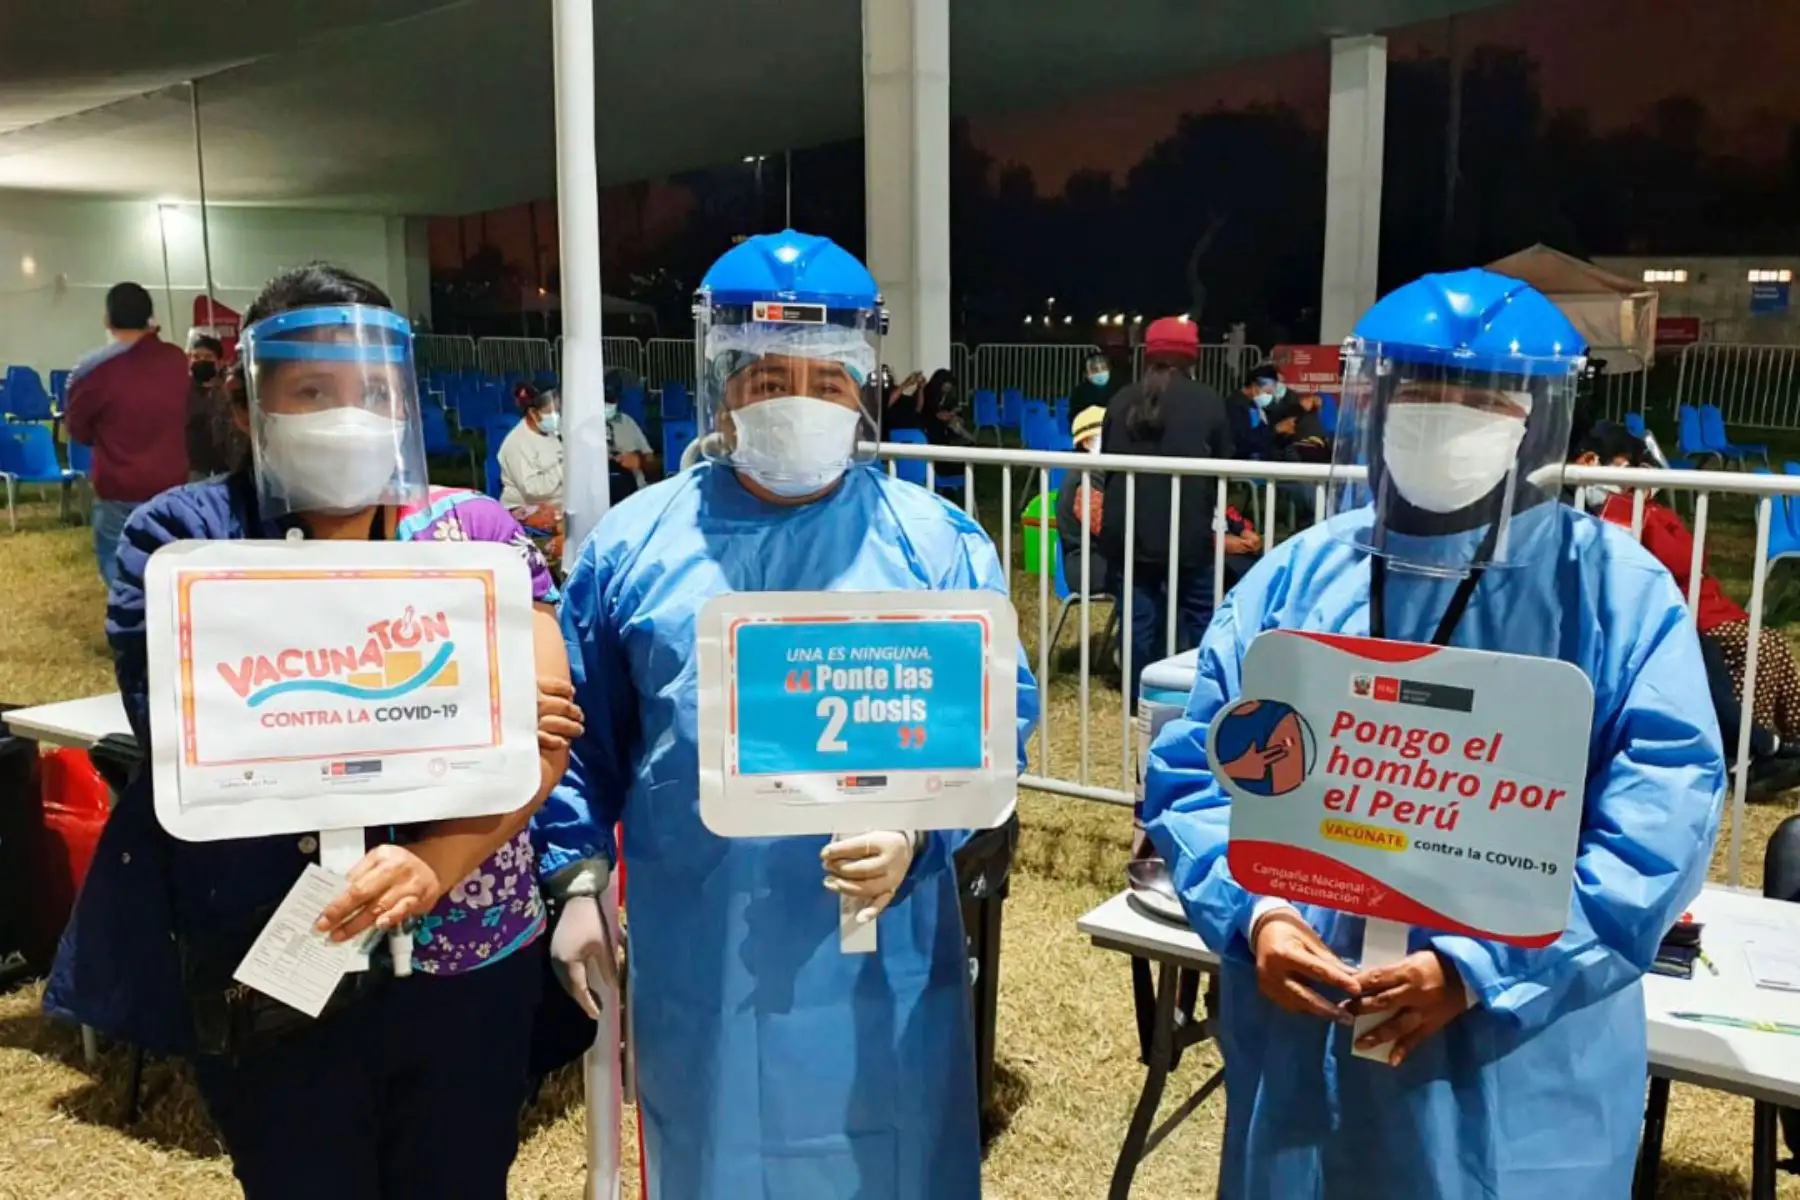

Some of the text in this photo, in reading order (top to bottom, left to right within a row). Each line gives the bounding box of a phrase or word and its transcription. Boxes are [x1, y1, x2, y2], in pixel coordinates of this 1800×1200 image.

[786, 647, 823, 662] UNA
[828, 647, 846, 661] ES
[894, 663, 933, 690] las
[260, 703, 458, 728] CONTRA LA COVID-19
[816, 694, 927, 752] 2 dosis
[1330, 710, 1503, 763] Pongo el
[1326, 745, 1567, 812] hombro por
[1323, 784, 1460, 831] el Perú
[1414, 839, 1463, 857] contra
[1468, 847, 1482, 860] la
[1486, 851, 1558, 876] COVID-19
[1269, 878, 1360, 904] de Vacunación
[1312, 873, 1366, 895] Nacional
